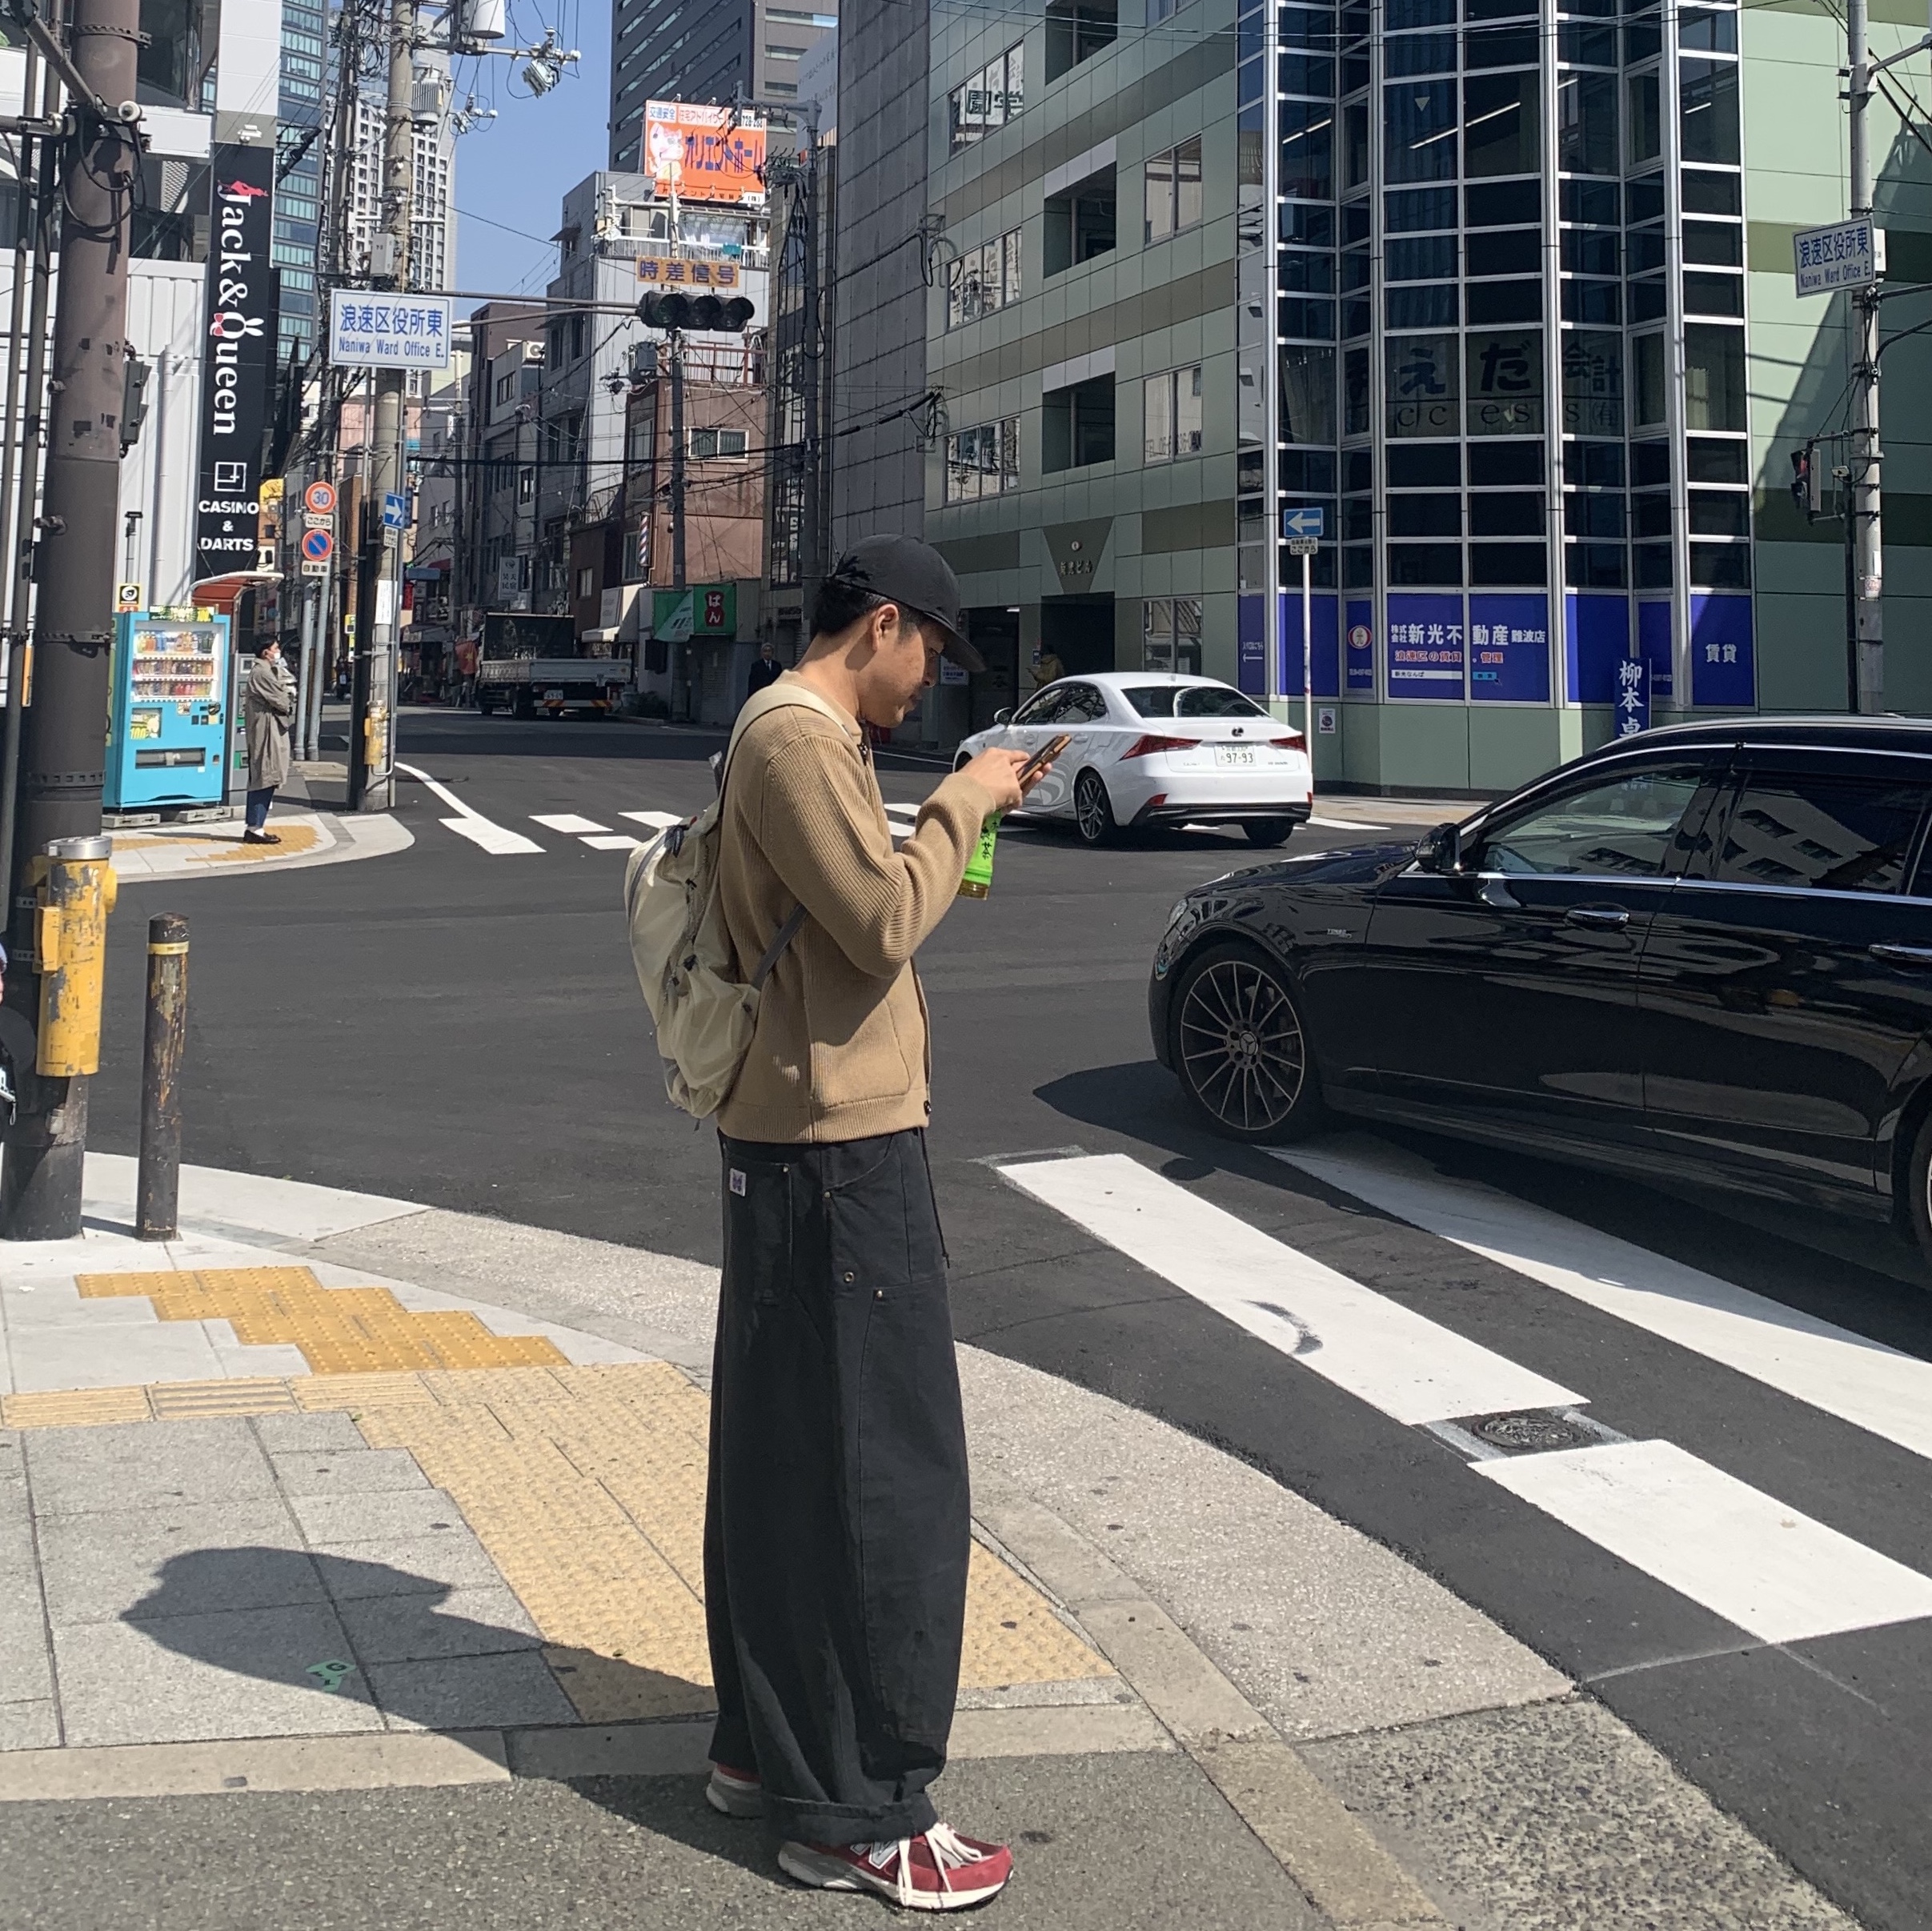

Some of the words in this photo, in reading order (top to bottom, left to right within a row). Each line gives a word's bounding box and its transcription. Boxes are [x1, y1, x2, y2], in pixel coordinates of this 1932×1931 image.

[1799, 226, 1869, 269] 浪速区役所東
[640, 259, 736, 285] 時差信号
[1800, 273, 1821, 288] Naniwa
[1825, 266, 1839, 283] Ward
[1843, 262, 1861, 281] Office
[340, 303, 443, 338] 浪速区役所東
[339, 336, 371, 354] Naniwa
[376, 339, 399, 355] Ward
[404, 340, 430, 358] Office
[435, 343, 444, 358] E.
[313, 491, 329, 505] 30
[198, 500, 259, 515] CASINO
[222, 520, 234, 532] &
[307, 518, 331, 527] ここから
[200, 538, 254, 551] DARTS
[303, 564, 328, 572] 自動車
[1706, 643, 1737, 663] 賃貸
[1226, 752, 1254, 763] 97-93
